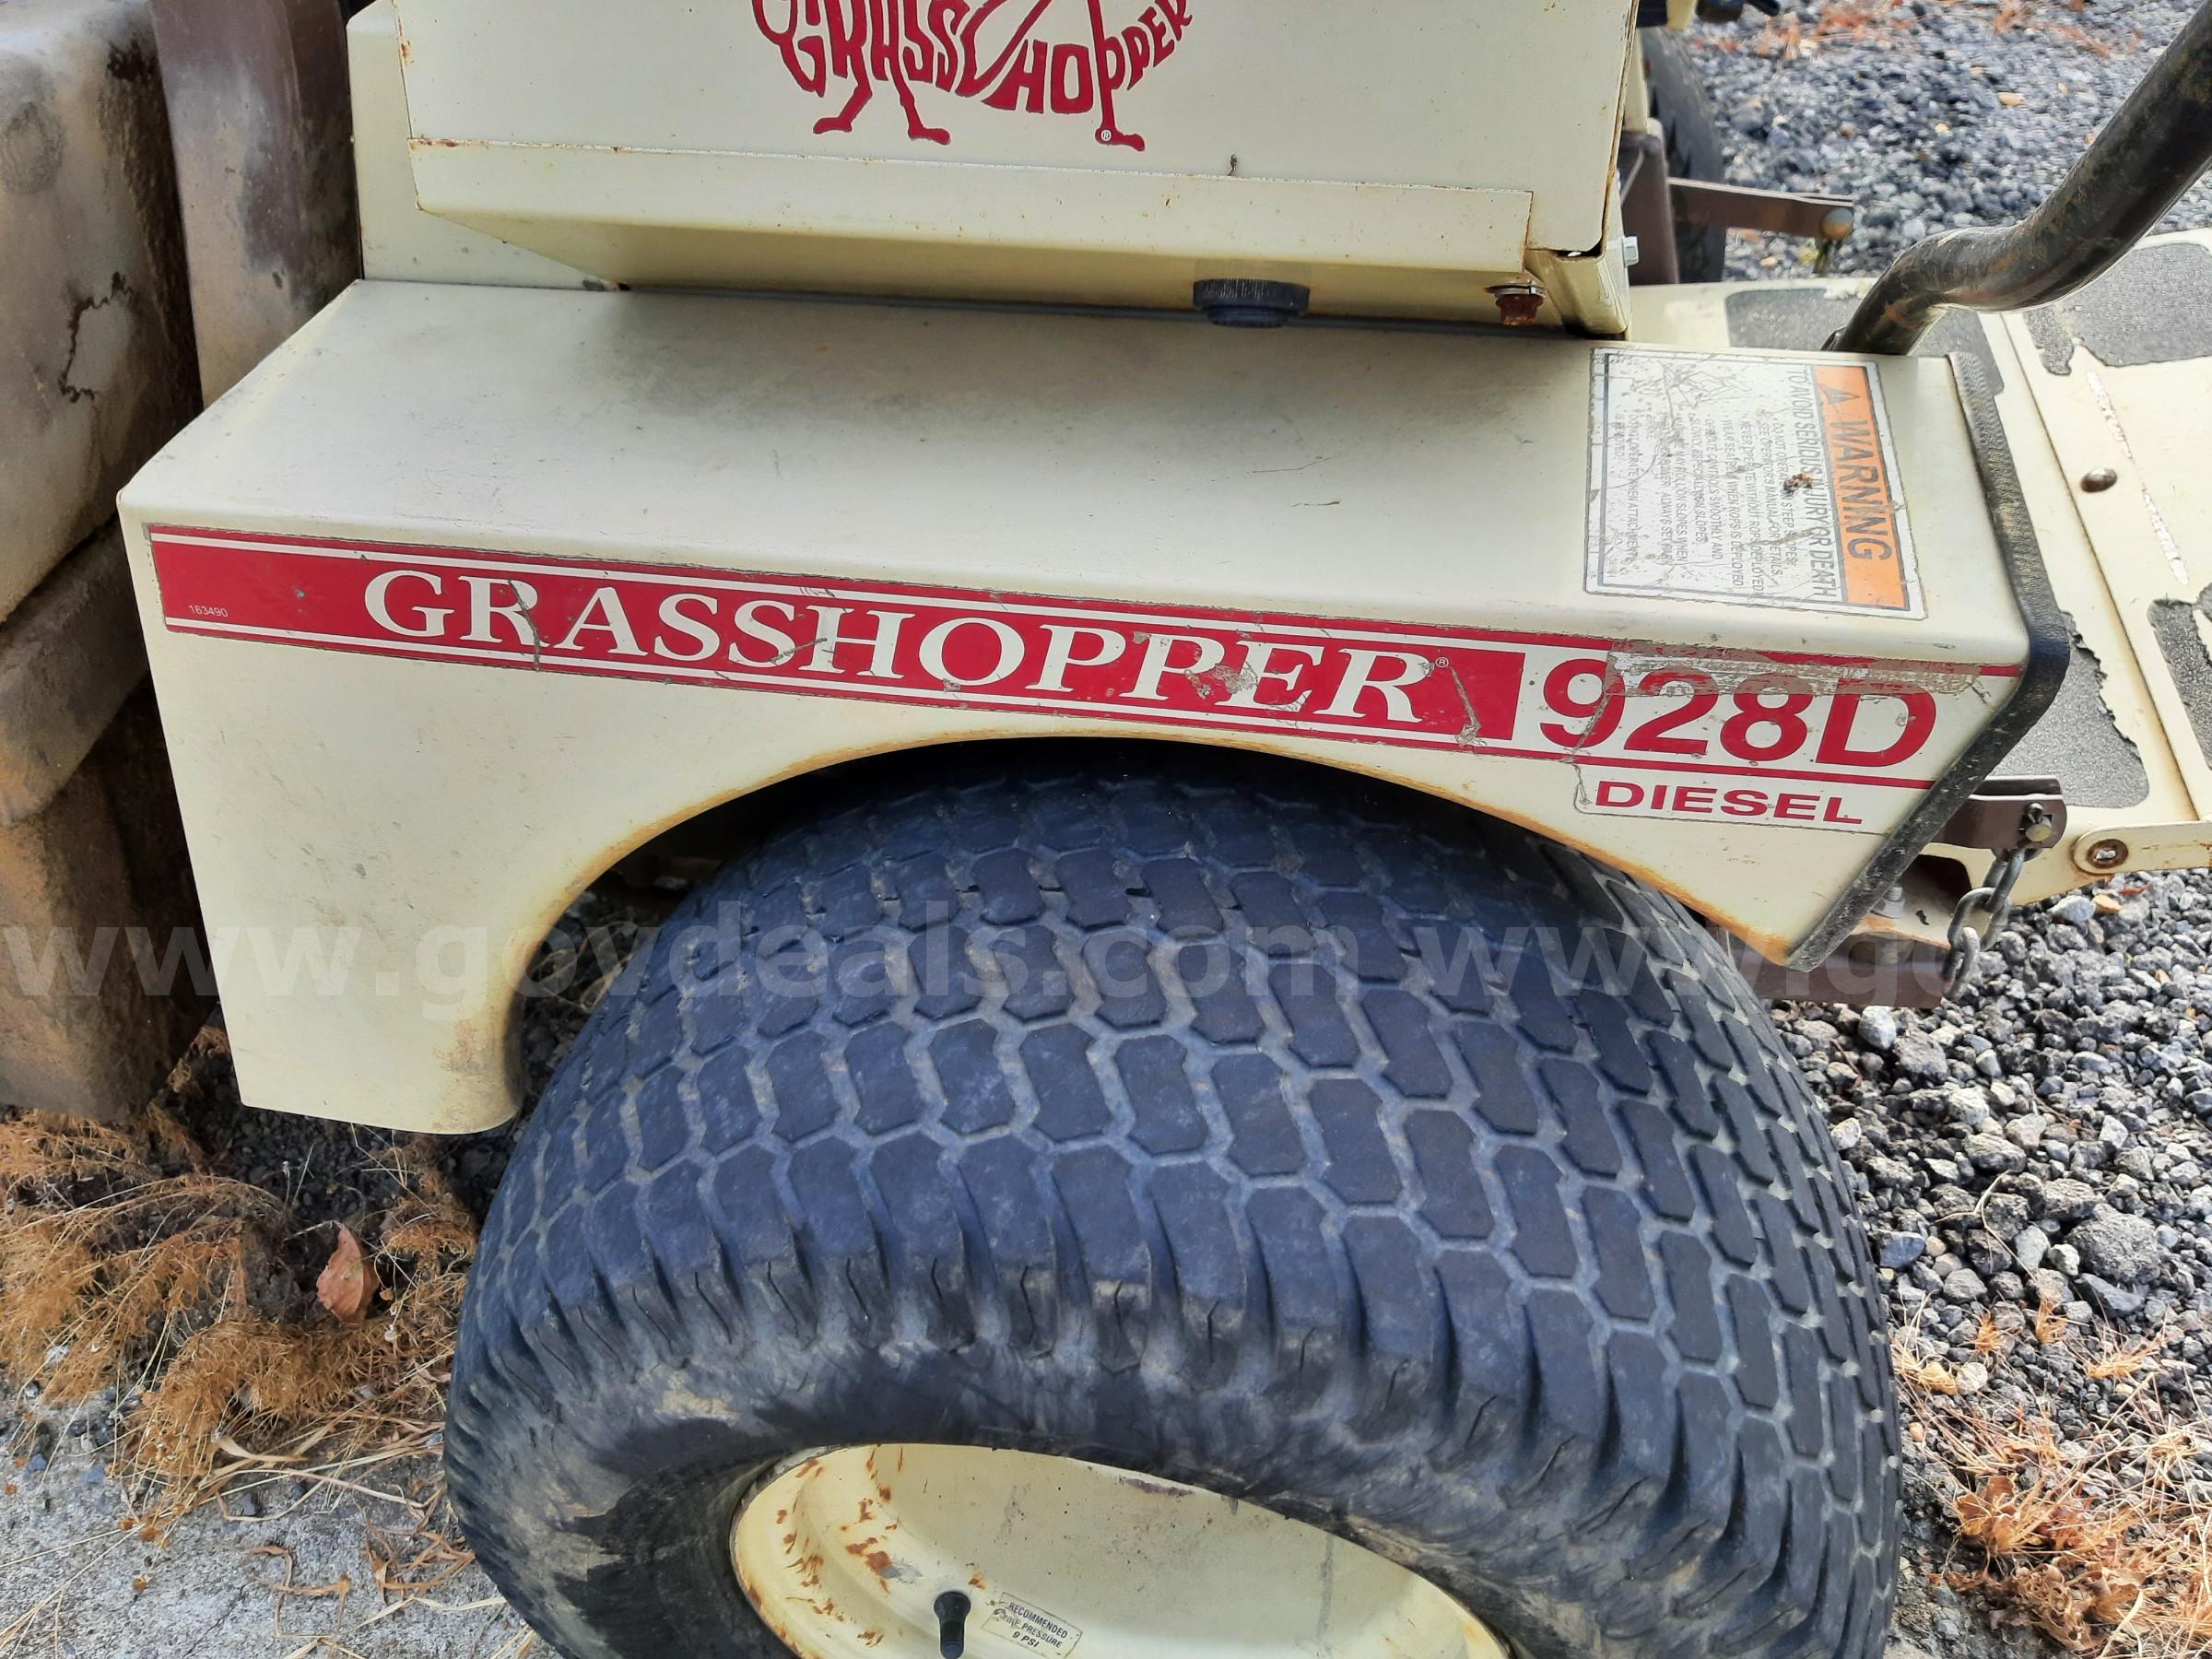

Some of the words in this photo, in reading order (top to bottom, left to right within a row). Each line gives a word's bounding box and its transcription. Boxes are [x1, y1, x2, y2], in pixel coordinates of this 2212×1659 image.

[1786, 368, 1808, 383] TO
[1788, 384, 1813, 418] AVOID
[1722, 419, 1734, 442] WEAR
[1739, 420, 1752, 445] NEVER
[1758, 422, 1770, 436] SEE
[1772, 422, 1784, 434] DO
[1774, 435, 1785, 450] NOT
[1793, 421, 1821, 474] SERIOUS
[1674, 466, 1686, 487] ROLL
[1675, 488, 1687, 501] ON
[1726, 480, 1739, 504] WHEN
[1745, 481, 1759, 519] WITHOUT
[1764, 486, 1778, 517] MANUAL
[1830, 418, 1894, 561] WARNING
[1659, 492, 1672, 525] ALWAYS
[1675, 502, 1688, 536] SLOPES
[1708, 495, 1723, 541] SMOOTHLY
[1728, 506, 1740, 528] ROPS
[1780, 501, 1794, 528] STEEP
[1661, 525, 1672, 542] SET
[1730, 530, 1741, 538] IS
[1747, 520, 1760, 543] ROPS
[1768, 522, 1780, 538] FOR
[1806, 525, 1830, 547] OR
[1676, 536, 1688, 561] WHEN
[1711, 542, 1724, 560] AND
[1768, 540, 1783, 576] ETAILS.
[1807, 548, 1837, 597] DEATH
[1539, 657, 1937, 768] 928D
[1595, 780, 1864, 825] DIESEL
[1008, 1602, 1068, 1640] RECOMMENDED
[1011, 1630, 1020, 1640] 9
[1020, 1635, 1041, 1649] PSI
[1021, 1623, 1063, 1649] PRESSURE
